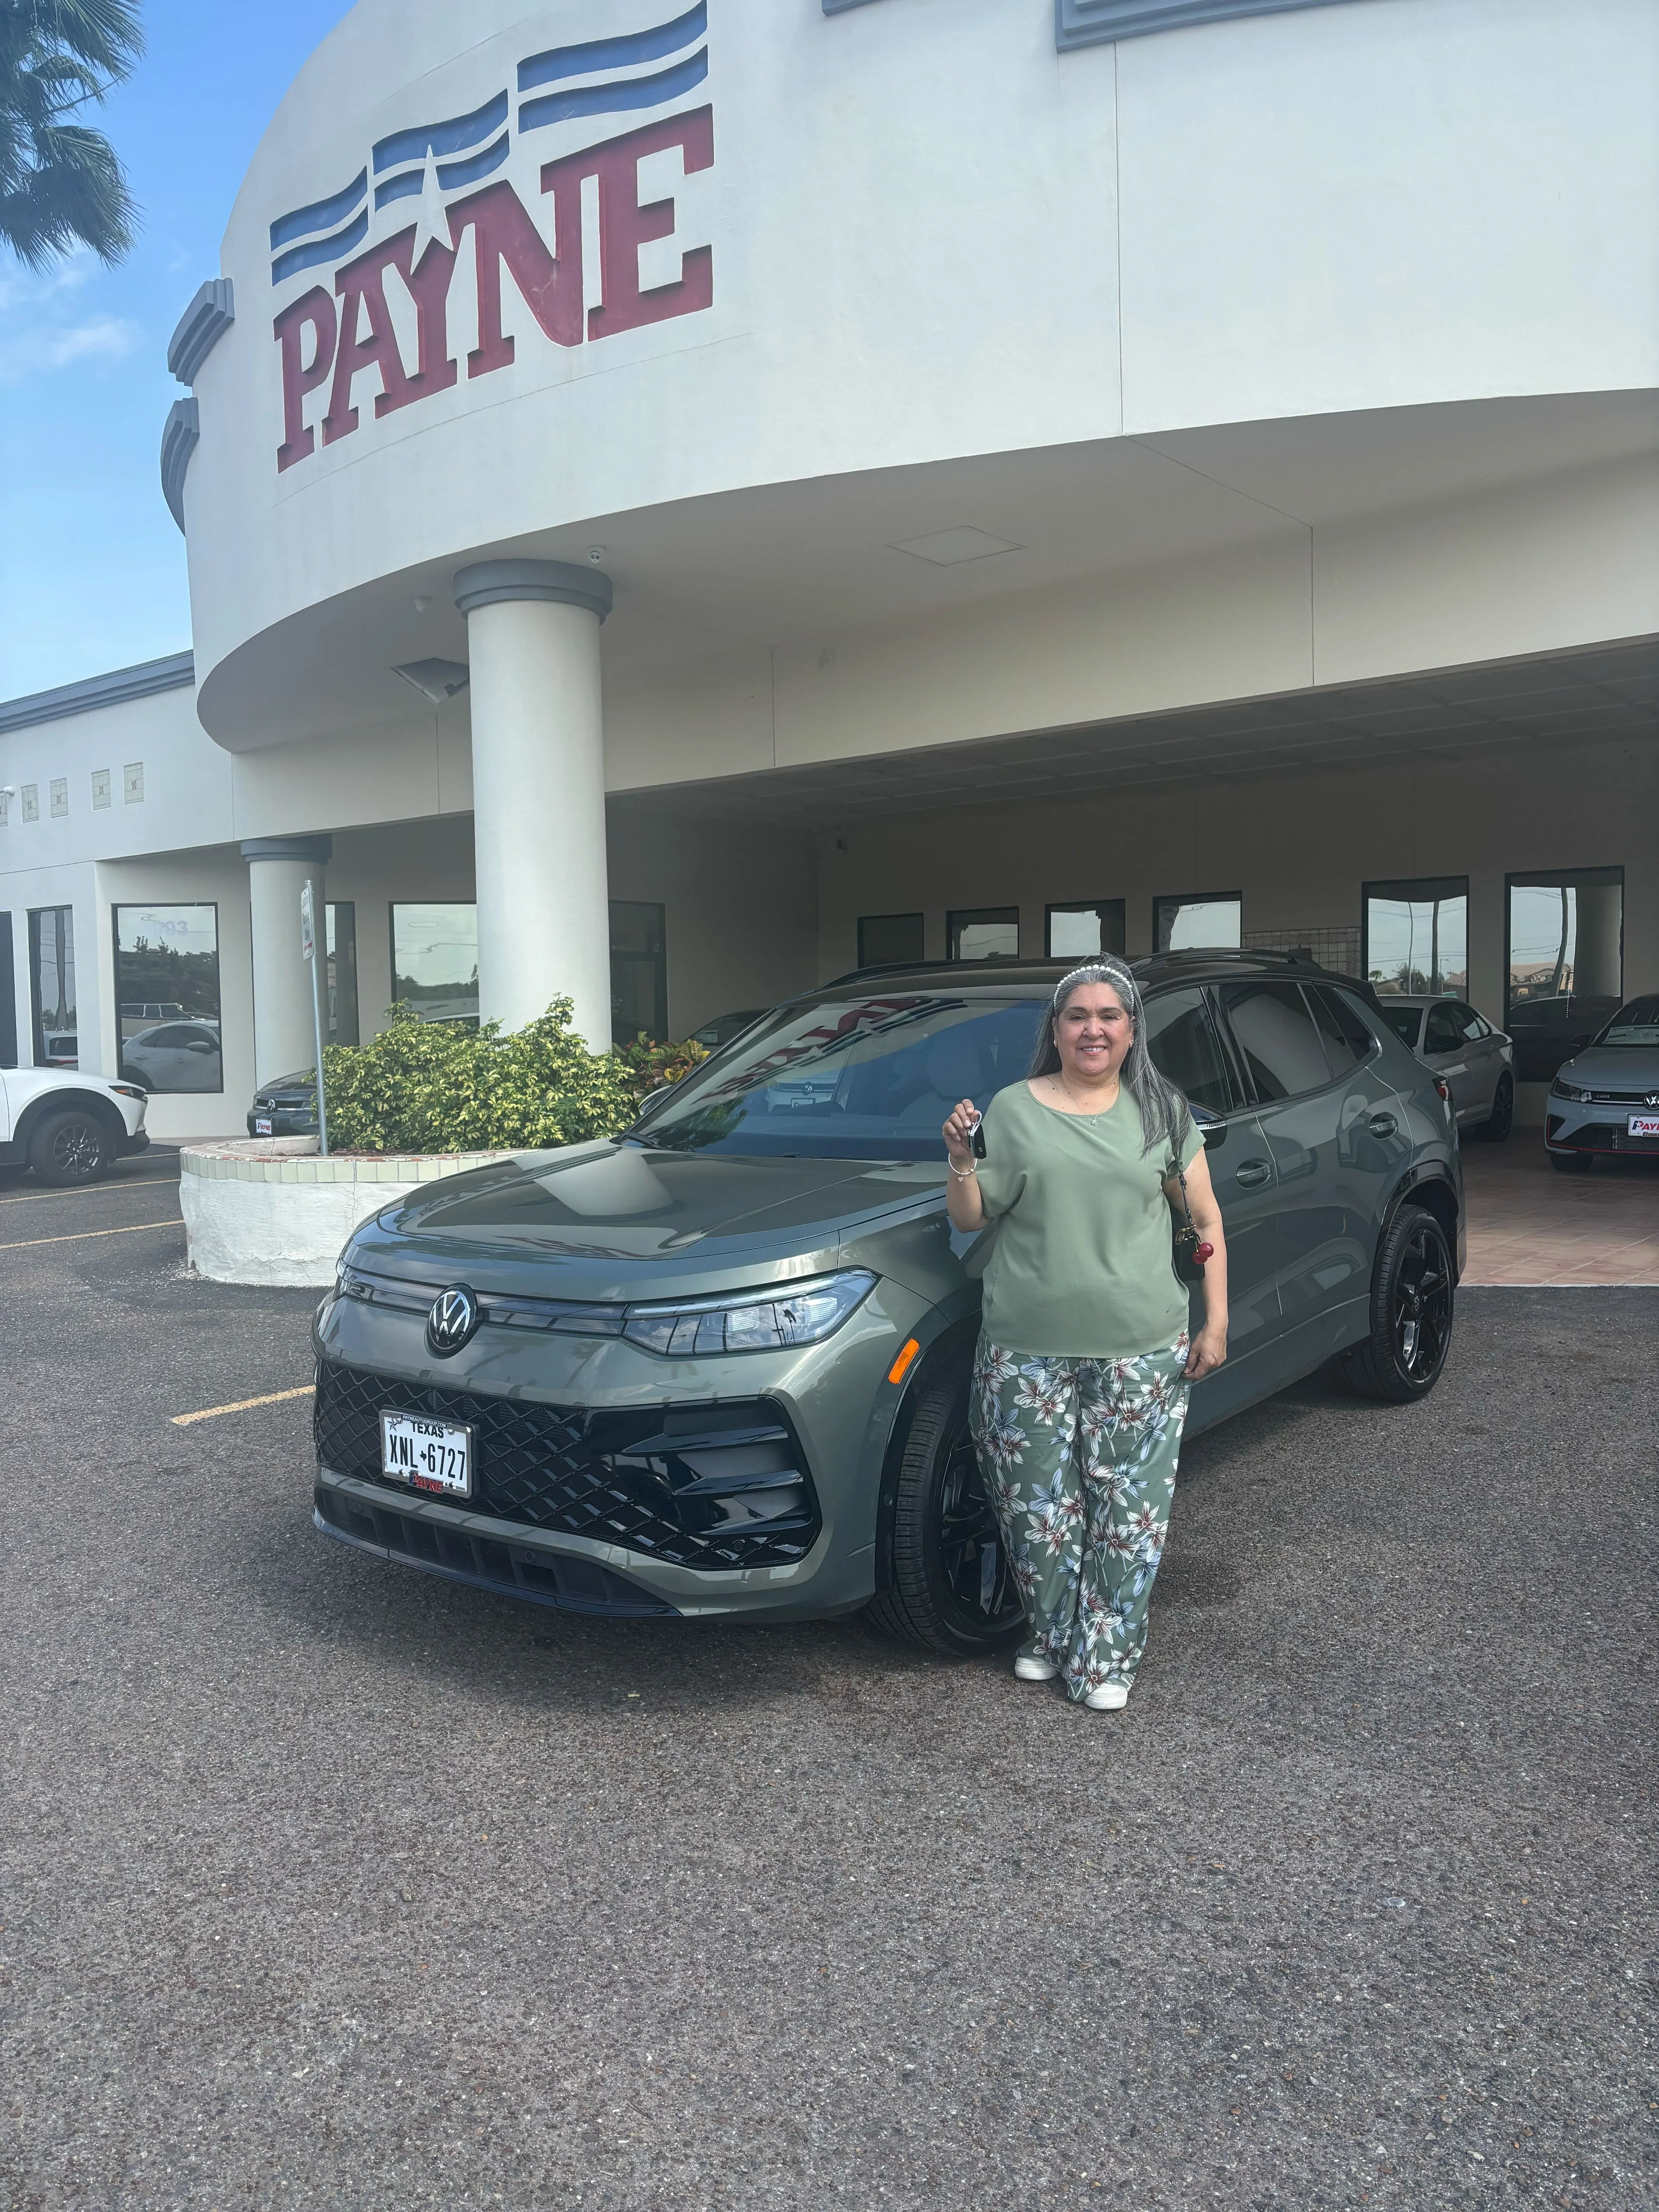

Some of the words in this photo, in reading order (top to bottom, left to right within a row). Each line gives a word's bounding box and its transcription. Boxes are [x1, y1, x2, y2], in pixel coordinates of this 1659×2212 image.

[273, 103, 715, 473] PAYNE
[258, 1122, 270, 1130] PAYNE
[402, 1415, 447, 1428] PAYNEAUTOGROUP.COM
[410, 1422, 444, 1439] TEXAS
[390, 1434, 418, 1468] XNL
[428, 1443, 465, 1480] 6727
[409, 1471, 443, 1493] PAYNE
